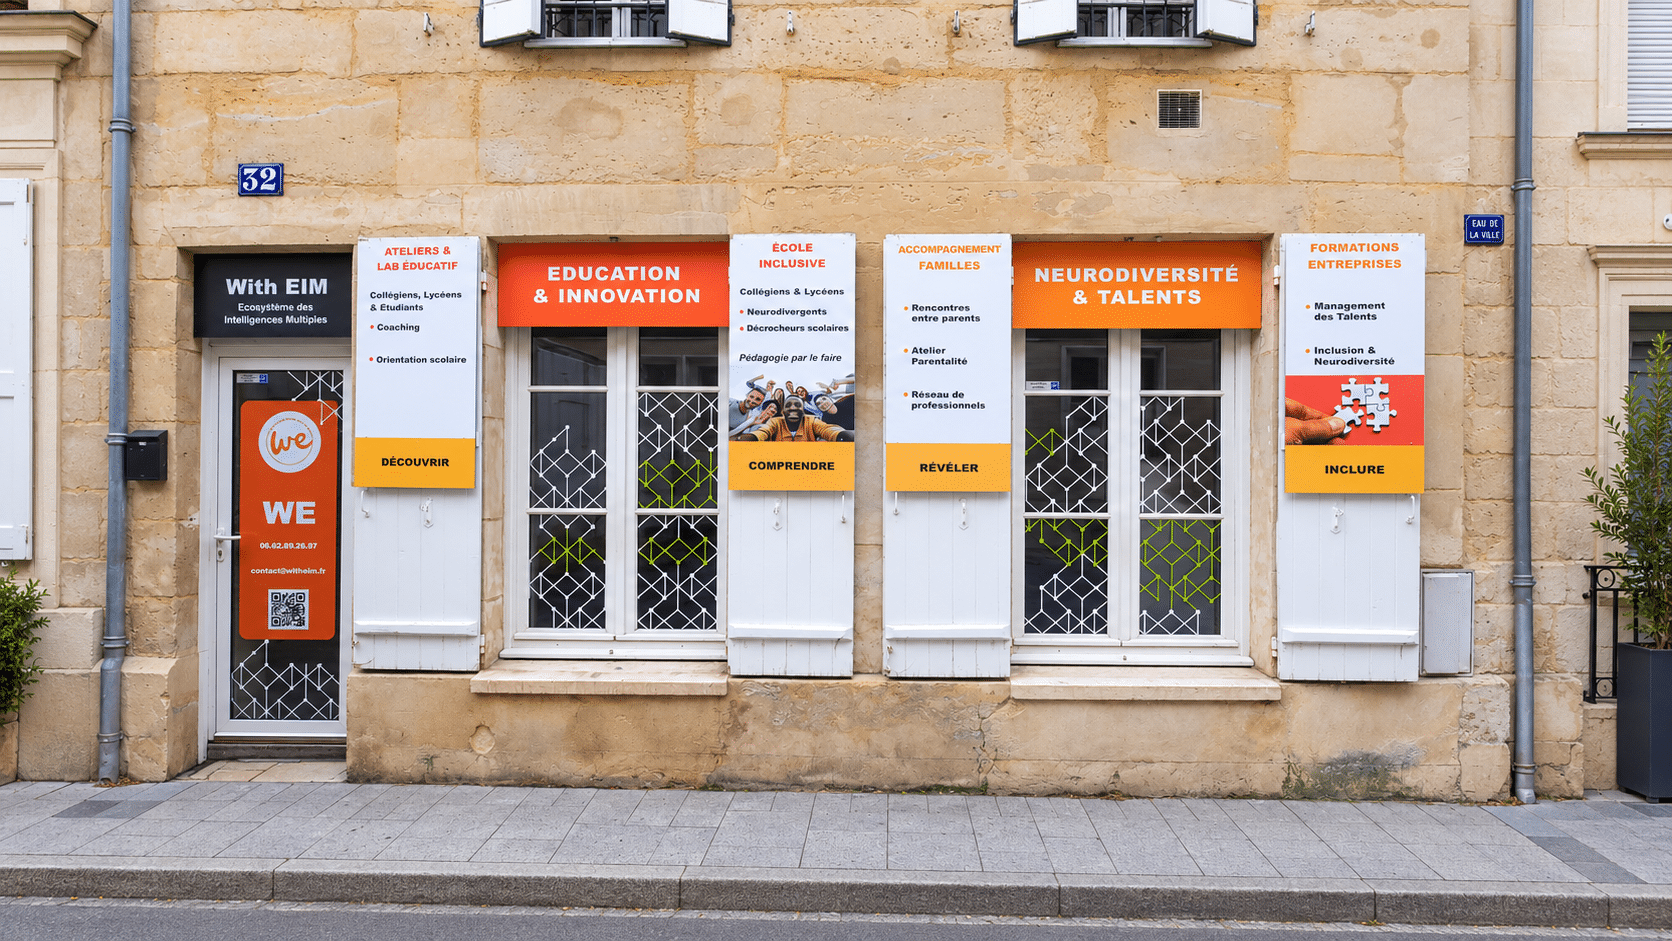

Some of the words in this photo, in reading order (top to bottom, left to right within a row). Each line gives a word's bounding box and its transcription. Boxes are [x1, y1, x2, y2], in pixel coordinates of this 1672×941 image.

[242, 167, 276, 190] 32
[1471, 219, 1487, 228] EAU
[1489, 218, 1499, 228] DE
[1469, 230, 1480, 239] LA
[1480, 230, 1501, 240] VILLE
[384, 246, 440, 257] ATELIERS
[442, 245, 451, 256] &
[772, 241, 814, 253] ÉCOLE
[898, 244, 1002, 254] ACCOMPAGNEMENT
[1310, 242, 1400, 253] FORMATIONS
[377, 262, 400, 272] LAB
[402, 259, 459, 271] ÉDUCATIF
[759, 258, 826, 269] INCLUSIVE
[918, 260, 981, 271] FAMILLES
[1307, 259, 1402, 270] ENTREPRISES
[548, 266, 679, 281] EDUCATION
[1035, 264, 1238, 282] NEURODIVERSITÉ
[226, 279, 277, 294] With
[286, 279, 327, 294] EIM
[369, 290, 421, 301] Collégiens,
[423, 290, 462, 301] Lycéens
[534, 289, 548, 303] &
[559, 289, 700, 303] INNOVATION
[739, 287, 791, 298] Collégiens
[793, 287, 801, 296] &
[804, 287, 845, 297] Lycéens
[1073, 290, 1088, 304] &
[1097, 290, 1201, 304] TALENTS
[296, 302, 314, 312] des
[369, 303, 378, 312] &
[379, 303, 424, 312] Etudiants
[746, 307, 828, 318] Neurodivergents
[911, 303, 971, 312] Rencontres
[1314, 302, 1386, 312] Management
[224, 314, 284, 326] Intelligences
[285, 314, 328, 326] Multiples
[911, 314, 939, 323] entre
[941, 314, 981, 324] parents
[1313, 312, 1334, 321] des
[1336, 312, 1378, 321] Talents
[376, 323, 420, 333] Coaching
[746, 323, 806, 333] Décrocheurs
[807, 323, 850, 332] scolaires
[911, 346, 947, 355] Atelier
[1314, 346, 1364, 355] Inclusion
[1367, 346, 1376, 355] &
[376, 355, 428, 364] Orientation
[429, 355, 467, 364] scolaire
[738, 353, 790, 364] Pédagogie
[790, 355, 808, 364] par
[809, 353, 819, 362] le
[820, 353, 842, 362] faire
[911, 357, 968, 366] Parentalité
[1314, 357, 1396, 366] Neurodiversité
[911, 390, 950, 399] Réseau
[951, 390, 965, 399] de
[911, 400, 986, 411] professionnels
[381, 455, 450, 468] DÉCOUVRIR
[748, 461, 835, 471] COMPRENDRE
[919, 461, 979, 473] RÉVÉLER
[1324, 464, 1385, 475] INCLURE
[263, 501, 316, 524] WE
[250, 567, 327, 575] contact@witheim.fr
